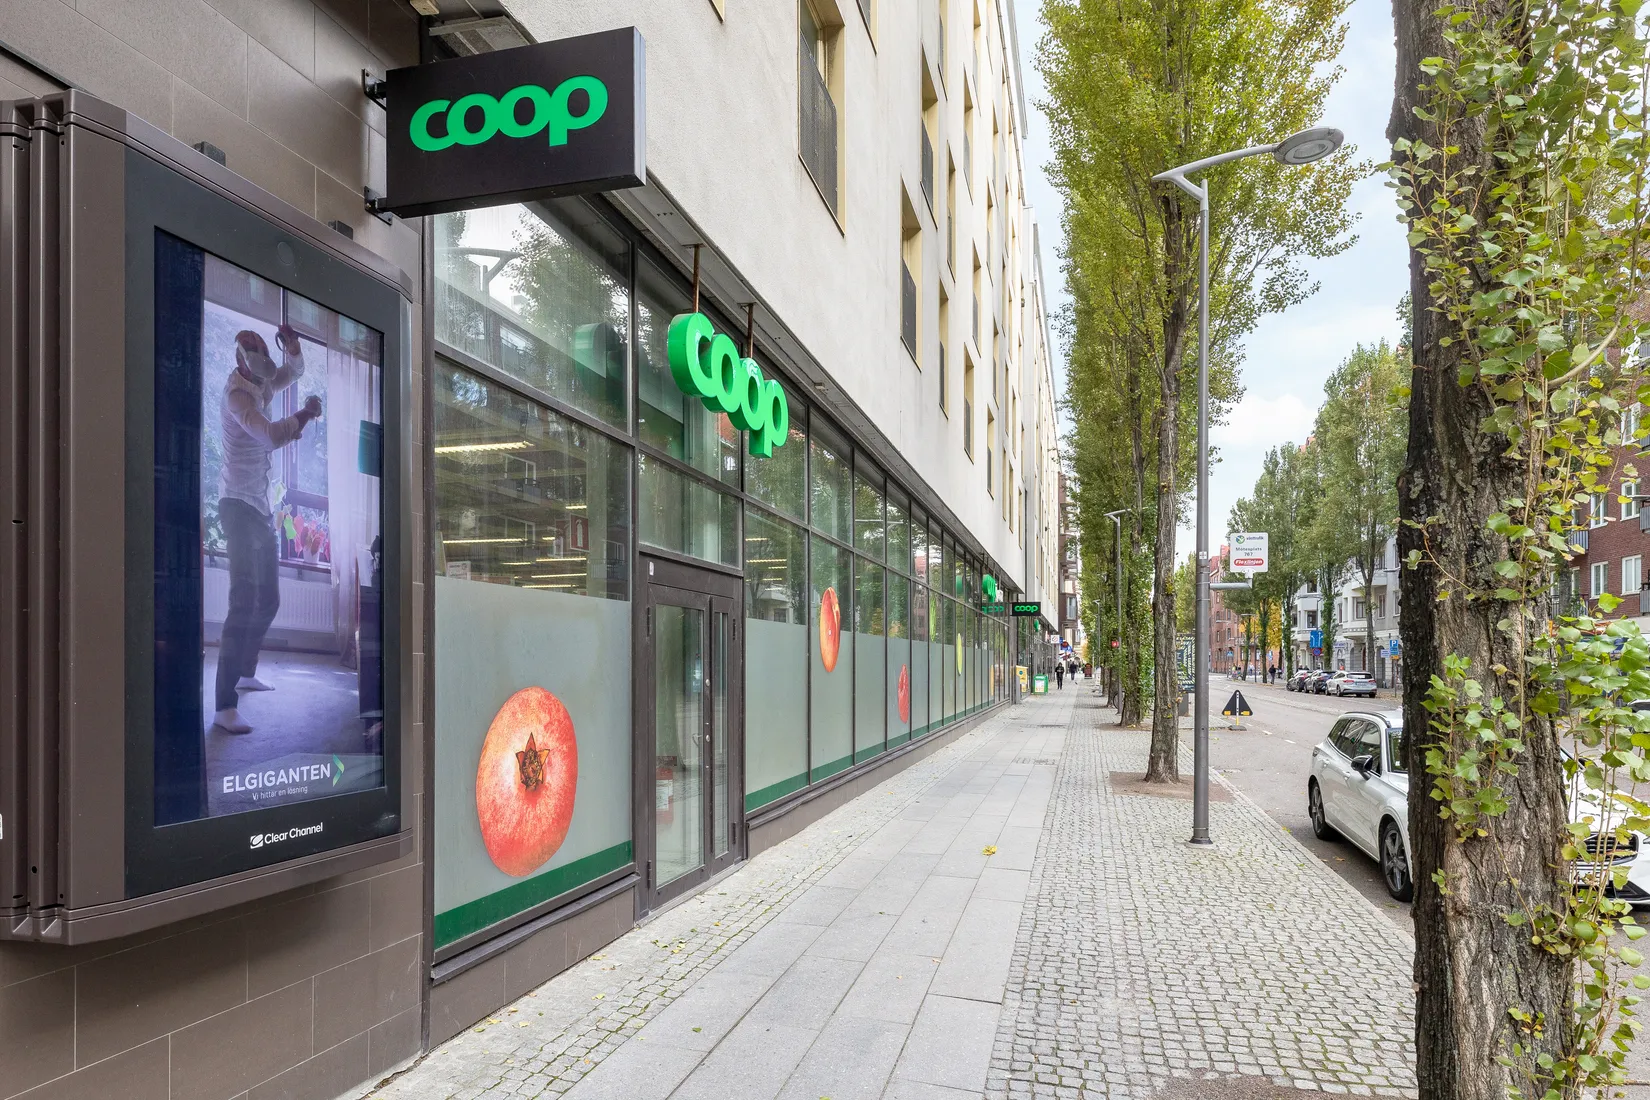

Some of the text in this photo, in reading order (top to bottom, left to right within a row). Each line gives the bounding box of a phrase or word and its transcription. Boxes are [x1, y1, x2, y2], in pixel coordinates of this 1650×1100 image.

[409, 75, 609, 152] coop
[668, 312, 789, 459] coop
[223, 763, 331, 793] ELGIGANTEN
[252, 792, 259, 801] Vi
[260, 790, 277, 799] hittar
[287, 786, 308, 795] lösning
[264, 822, 323, 845] Clear Channel
